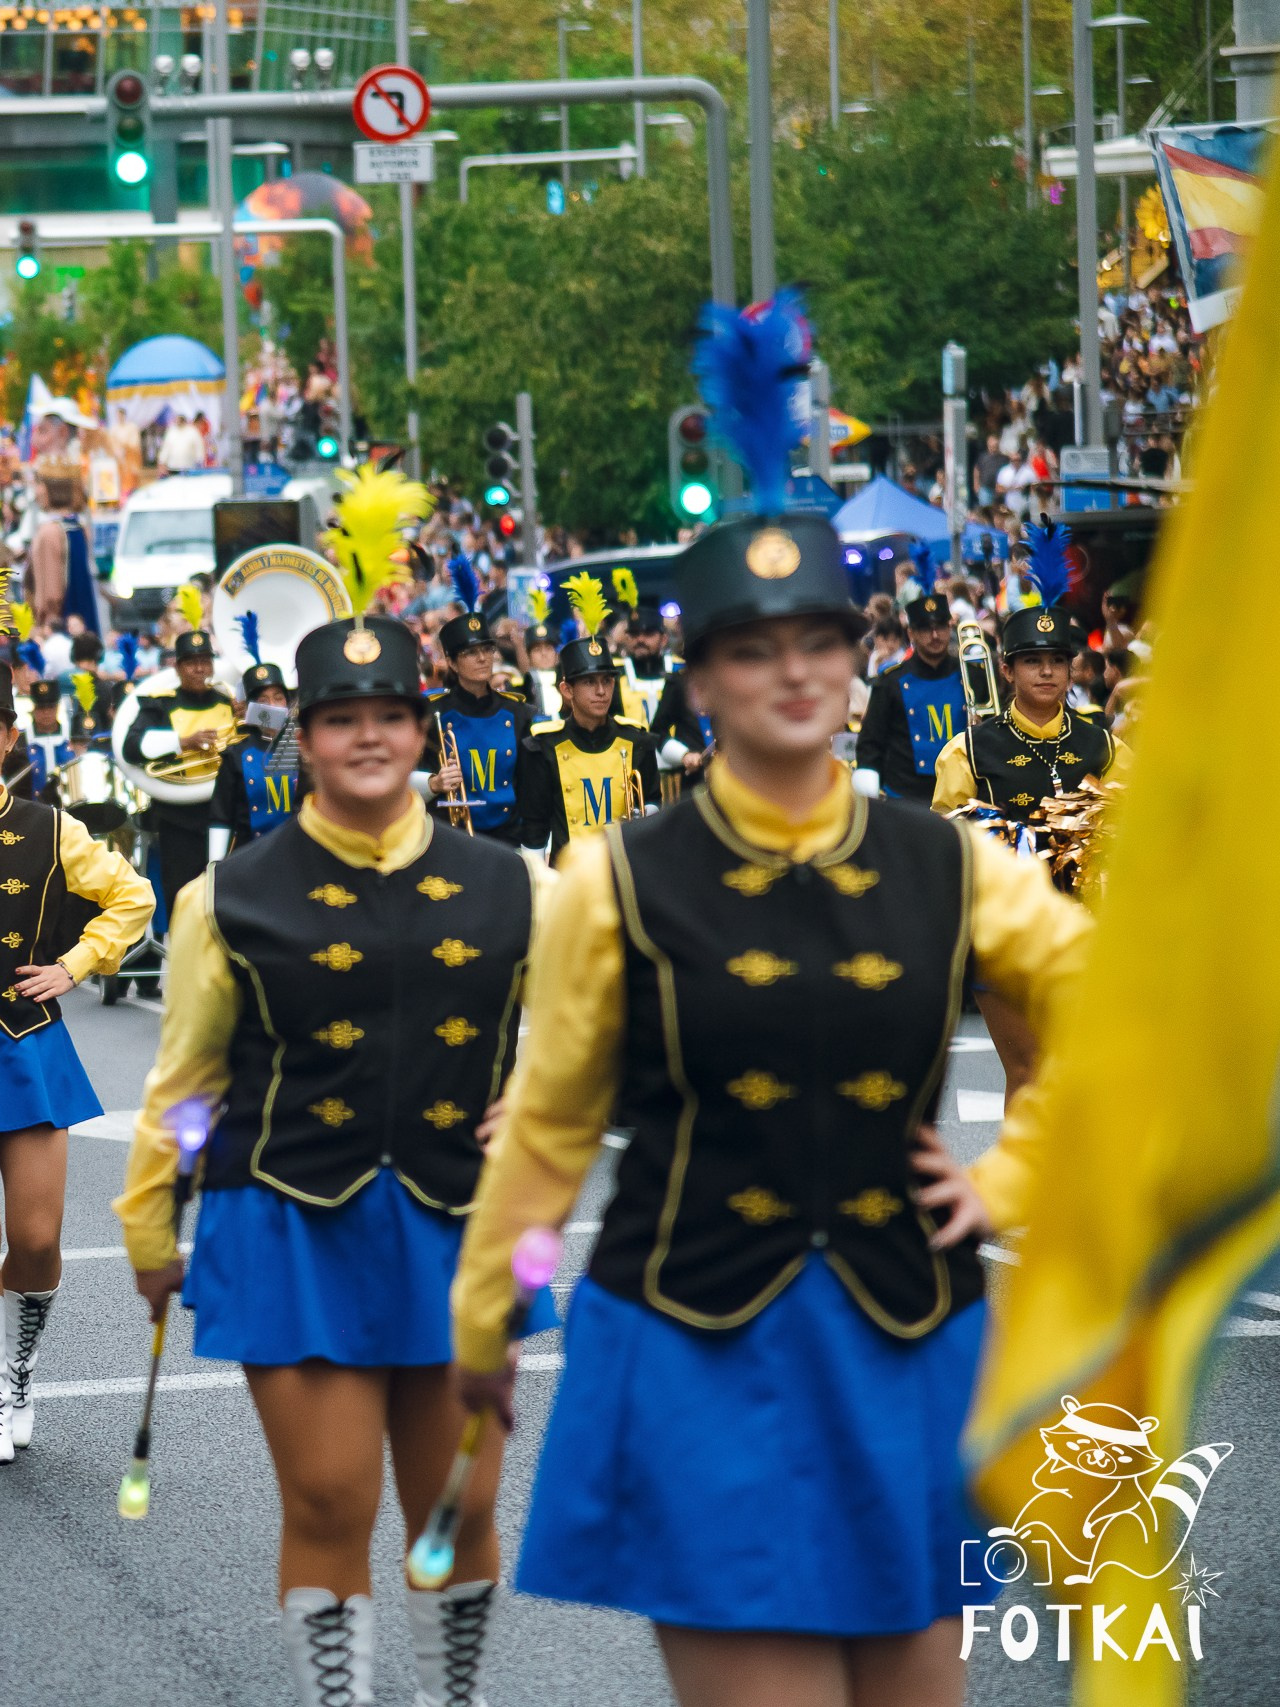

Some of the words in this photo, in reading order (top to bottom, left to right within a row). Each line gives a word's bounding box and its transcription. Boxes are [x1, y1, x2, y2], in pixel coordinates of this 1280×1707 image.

[241, 557, 263, 577] BANDA
[269, 555, 316, 575] MAJORETTES
[927, 703, 953, 741] M
[468, 749, 497, 792] M
[264, 775, 290, 813] M
[580, 777, 614, 826] M
